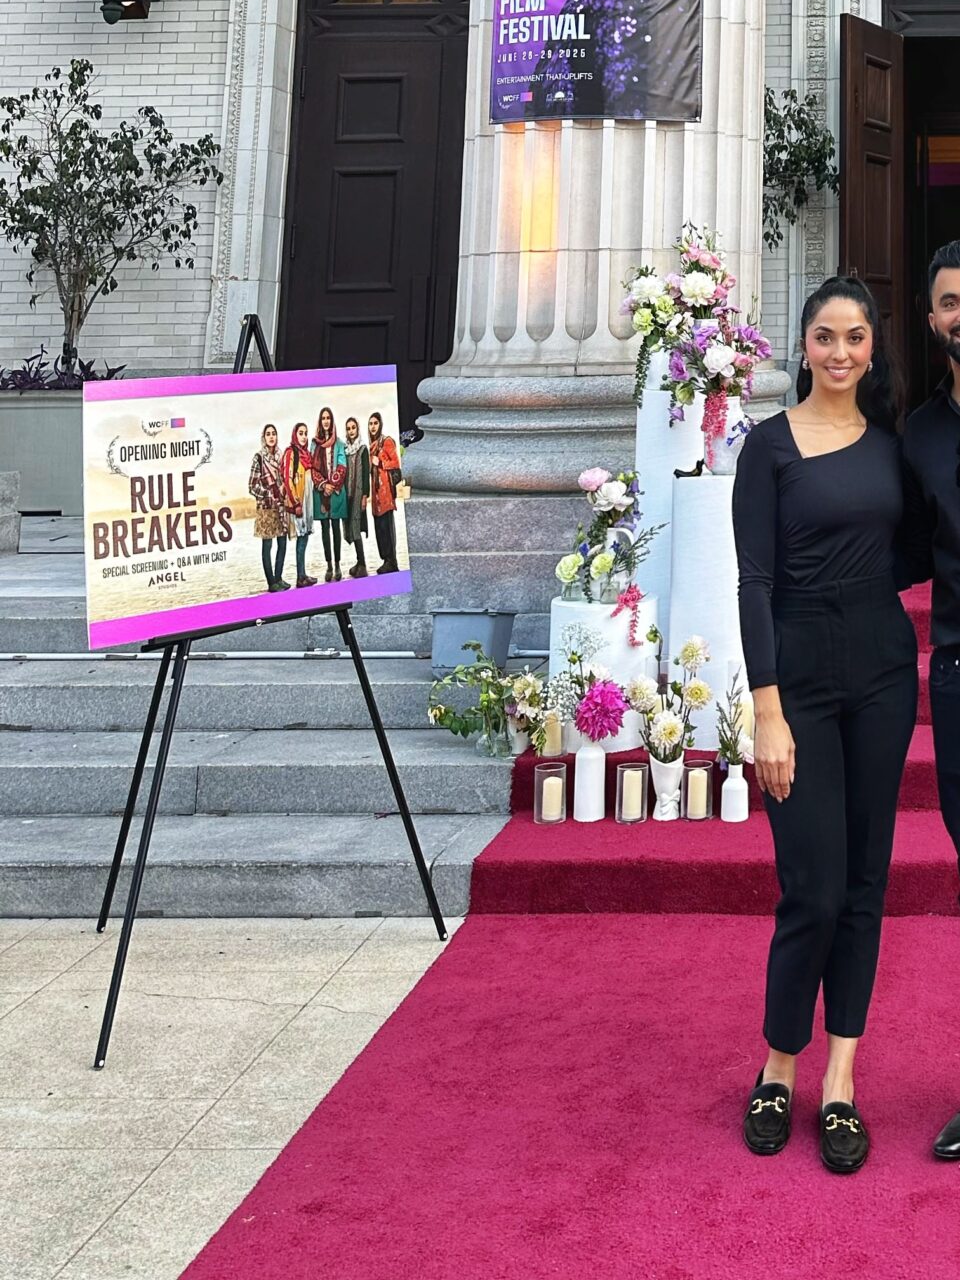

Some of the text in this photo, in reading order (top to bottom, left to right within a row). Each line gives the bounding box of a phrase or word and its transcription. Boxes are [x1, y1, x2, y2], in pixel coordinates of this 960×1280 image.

[499, 13, 591, 45] FESTIVAL
[497, 52, 517, 63] JUNE
[559, 48, 586, 58] 2025
[496, 73, 544, 85] ENTERTAINMENT
[563, 72, 593, 80] UPLIFTS
[502, 94, 520, 102] WCFF
[148, 420, 169, 429] WCFF
[120, 440, 201, 462] OPENING NIGHT
[130, 471, 197, 513] RULE
[93, 507, 233, 560] BREAKERS
[102, 565, 129, 578] SPECIAL
[132, 559, 168, 574] SCREENING
[177, 556, 191, 568] Q&A
[193, 553, 210, 565] WITH
[211, 551, 228, 562] CAST
[148, 572, 186, 587] ANGEL
